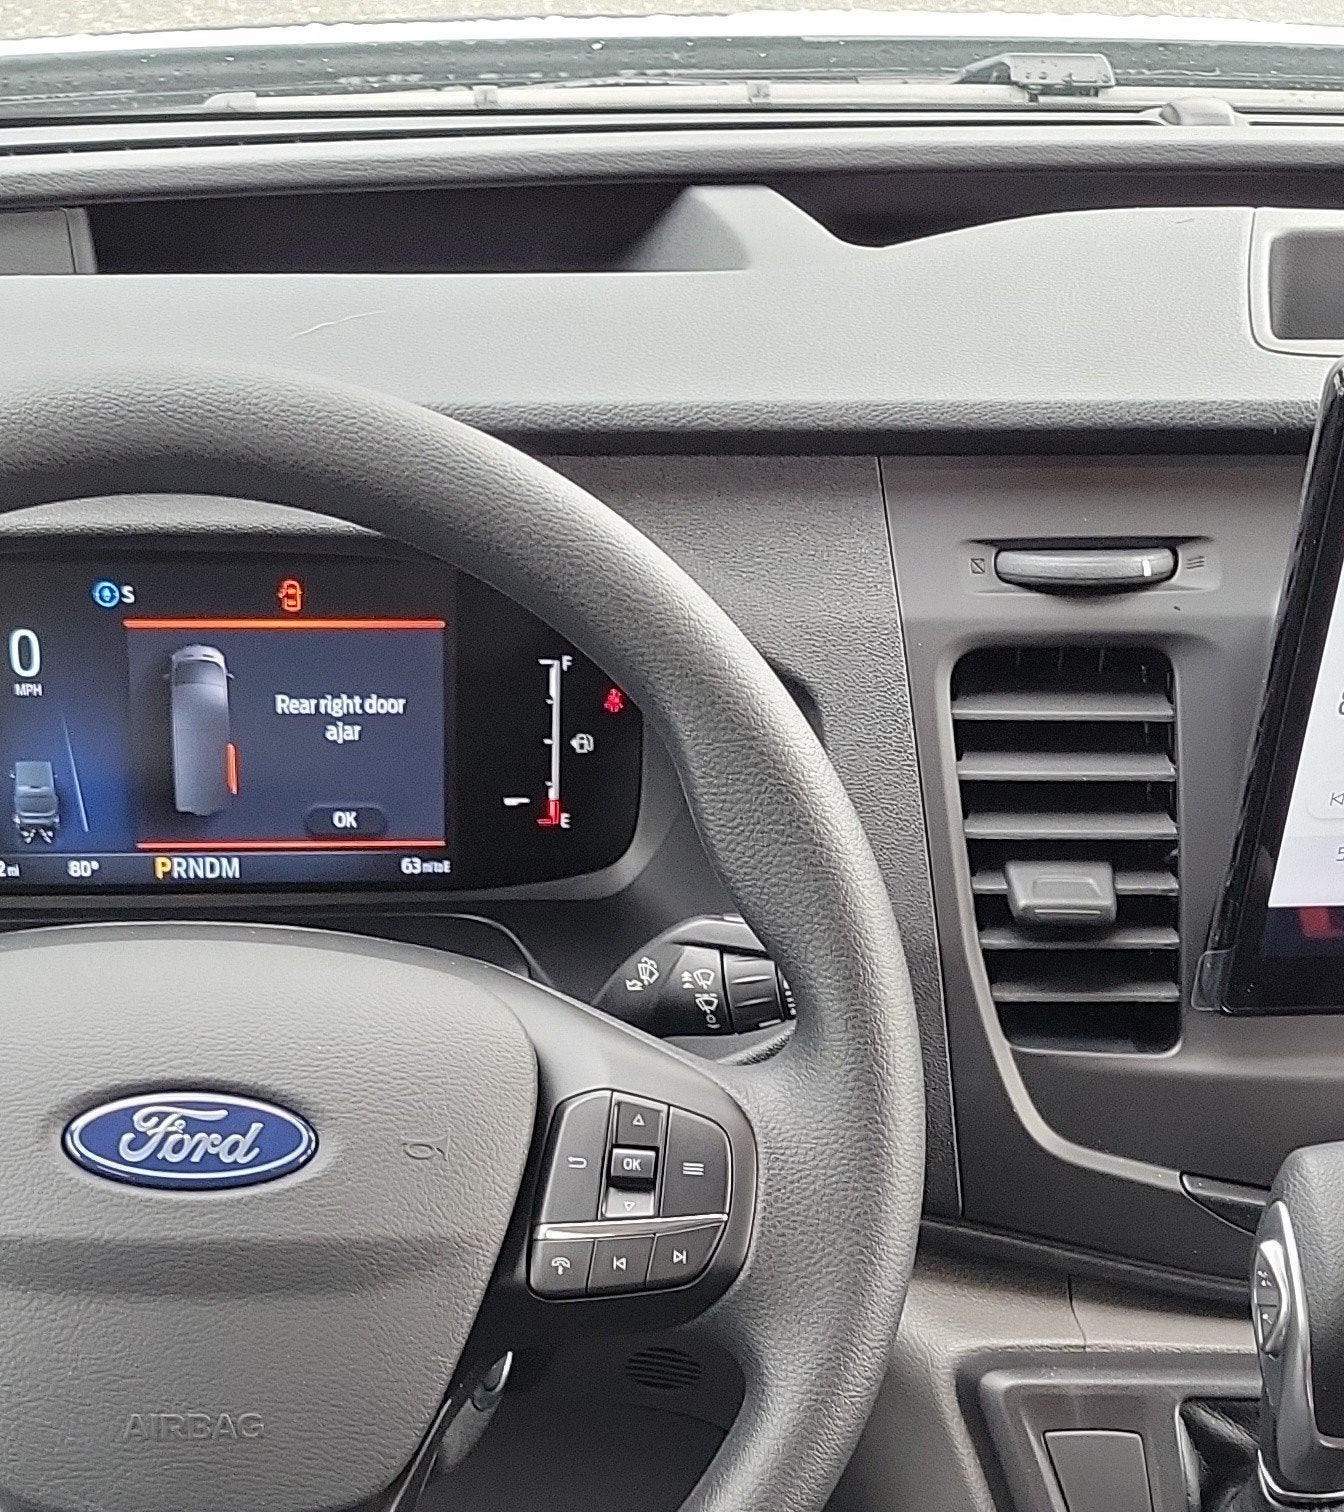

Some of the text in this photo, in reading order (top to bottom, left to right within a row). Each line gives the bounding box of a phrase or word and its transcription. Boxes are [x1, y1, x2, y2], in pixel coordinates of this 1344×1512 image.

[9, 628, 42, 678] 0
[561, 655, 573, 672] F
[13, 683, 43, 697] MPH
[274, 693, 407, 718] Rear right door
[324, 721, 362, 744] ajar
[332, 811, 358, 828] OK
[559, 813, 571, 829] E
[117, 1104, 265, 1166] Ford
[623, 1157, 642, 1172] OK
[120, 1411, 266, 1442] AIRBAG
